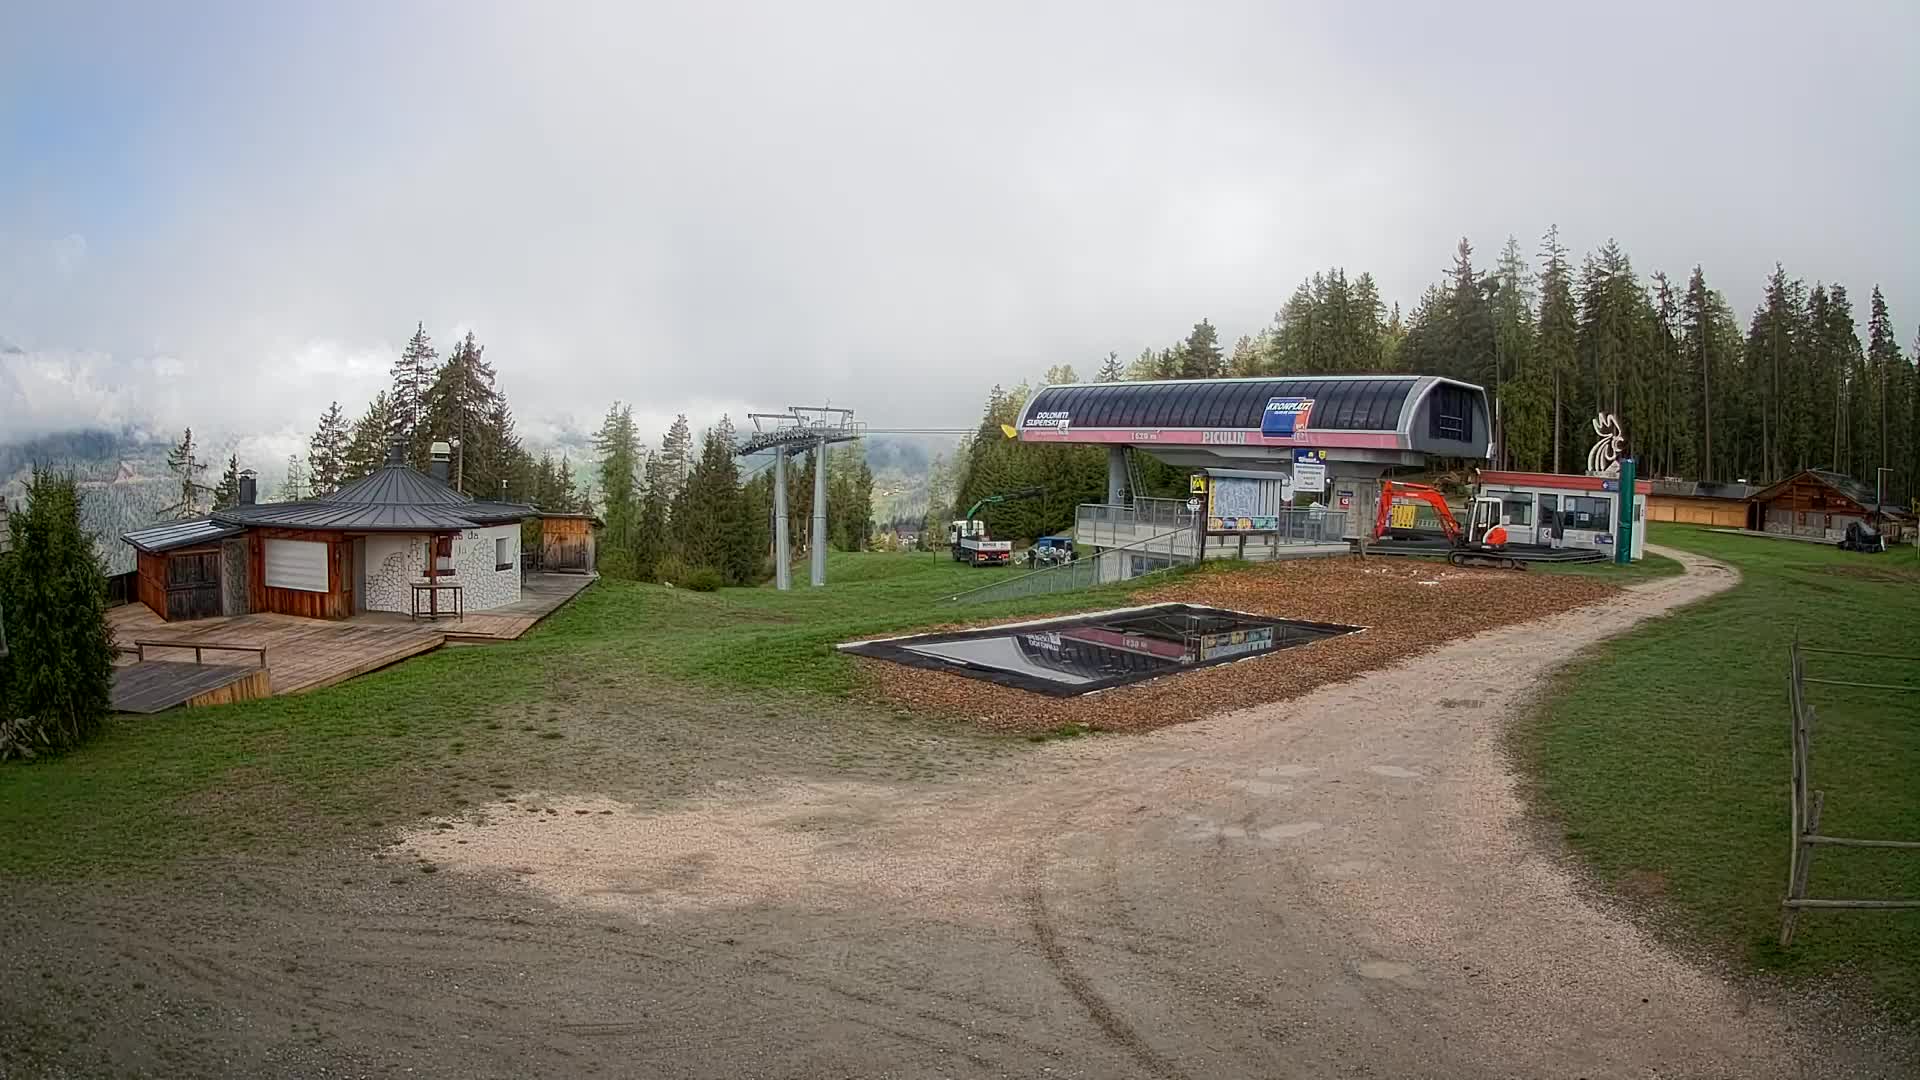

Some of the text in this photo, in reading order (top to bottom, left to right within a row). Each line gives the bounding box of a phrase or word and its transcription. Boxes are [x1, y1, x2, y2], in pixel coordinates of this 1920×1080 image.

[1266, 402, 1313, 411] KRONPLATZ
[1036, 411, 1069, 419] DOLOMITI
[1202, 431, 1246, 445] PICULIN
